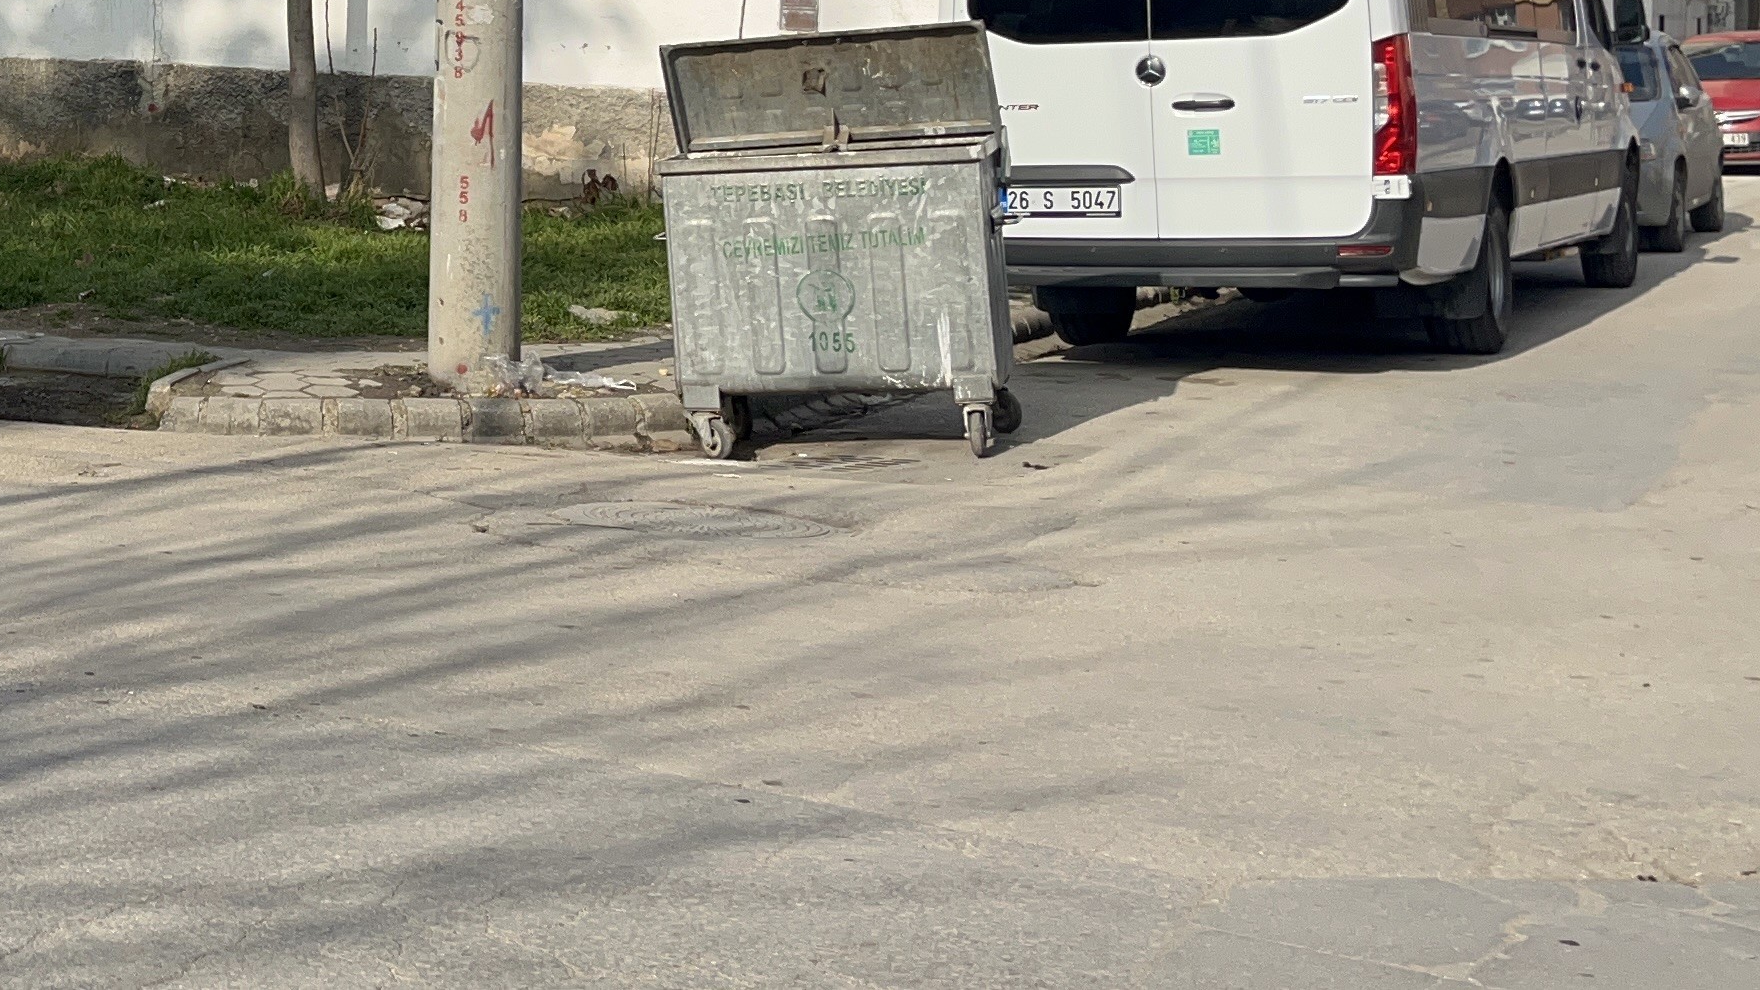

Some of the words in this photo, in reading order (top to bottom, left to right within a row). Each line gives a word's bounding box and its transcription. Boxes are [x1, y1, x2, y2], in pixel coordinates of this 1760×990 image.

[1008, 190, 1029, 210] 26
[1043, 191, 1054, 210] S
[1070, 190, 1116, 210] 5047
